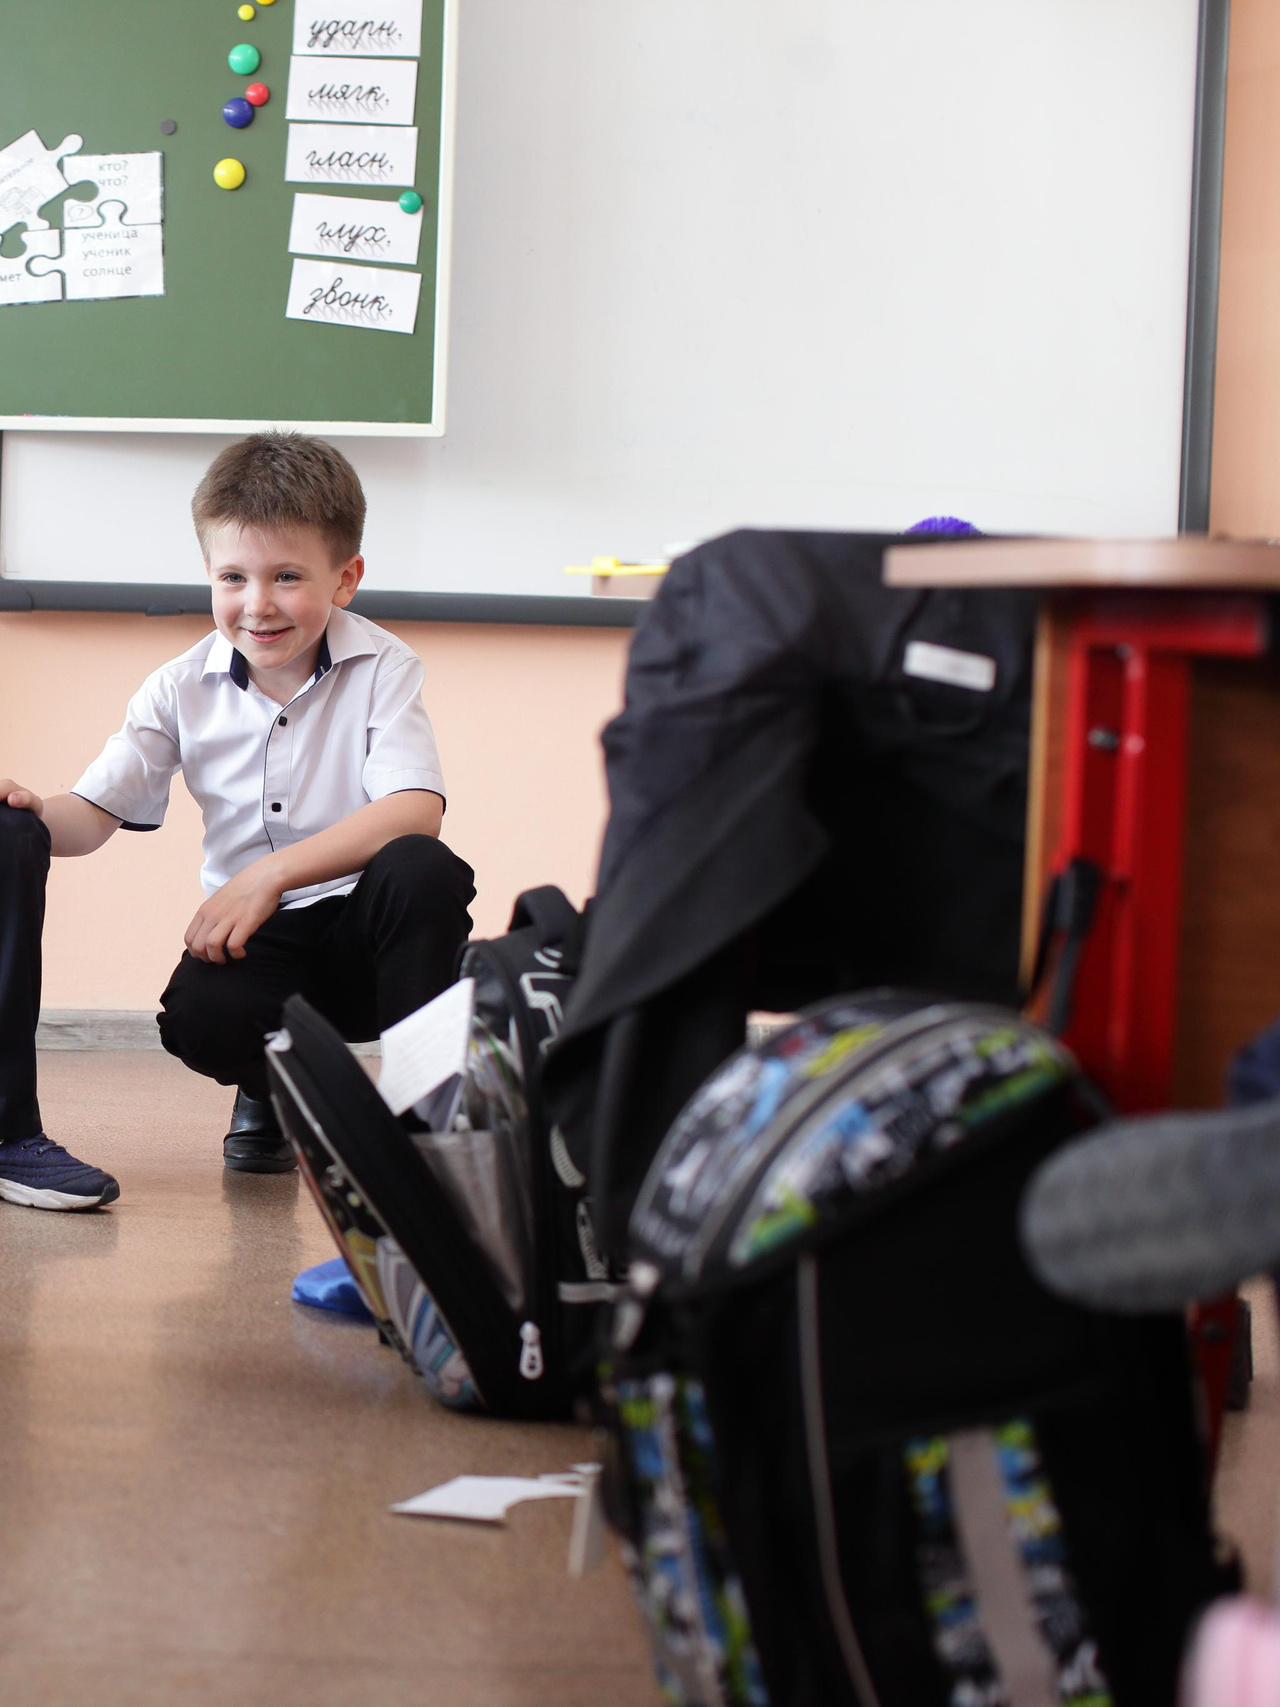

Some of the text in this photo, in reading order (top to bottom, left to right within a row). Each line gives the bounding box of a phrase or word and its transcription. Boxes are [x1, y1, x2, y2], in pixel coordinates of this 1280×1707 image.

[307, 20, 402, 49] ударн.
[308, 83, 390, 103] мягк.
[98, 160, 128, 172] кто?
[306, 150, 393, 171] гласн.
[98, 175, 128, 187] что?
[81, 229, 139, 243] ученица
[316, 222, 391, 252] глух.
[82, 247, 132, 261] ученик
[83, 265, 132, 279] солнце
[303, 278, 393, 315] звонк.
